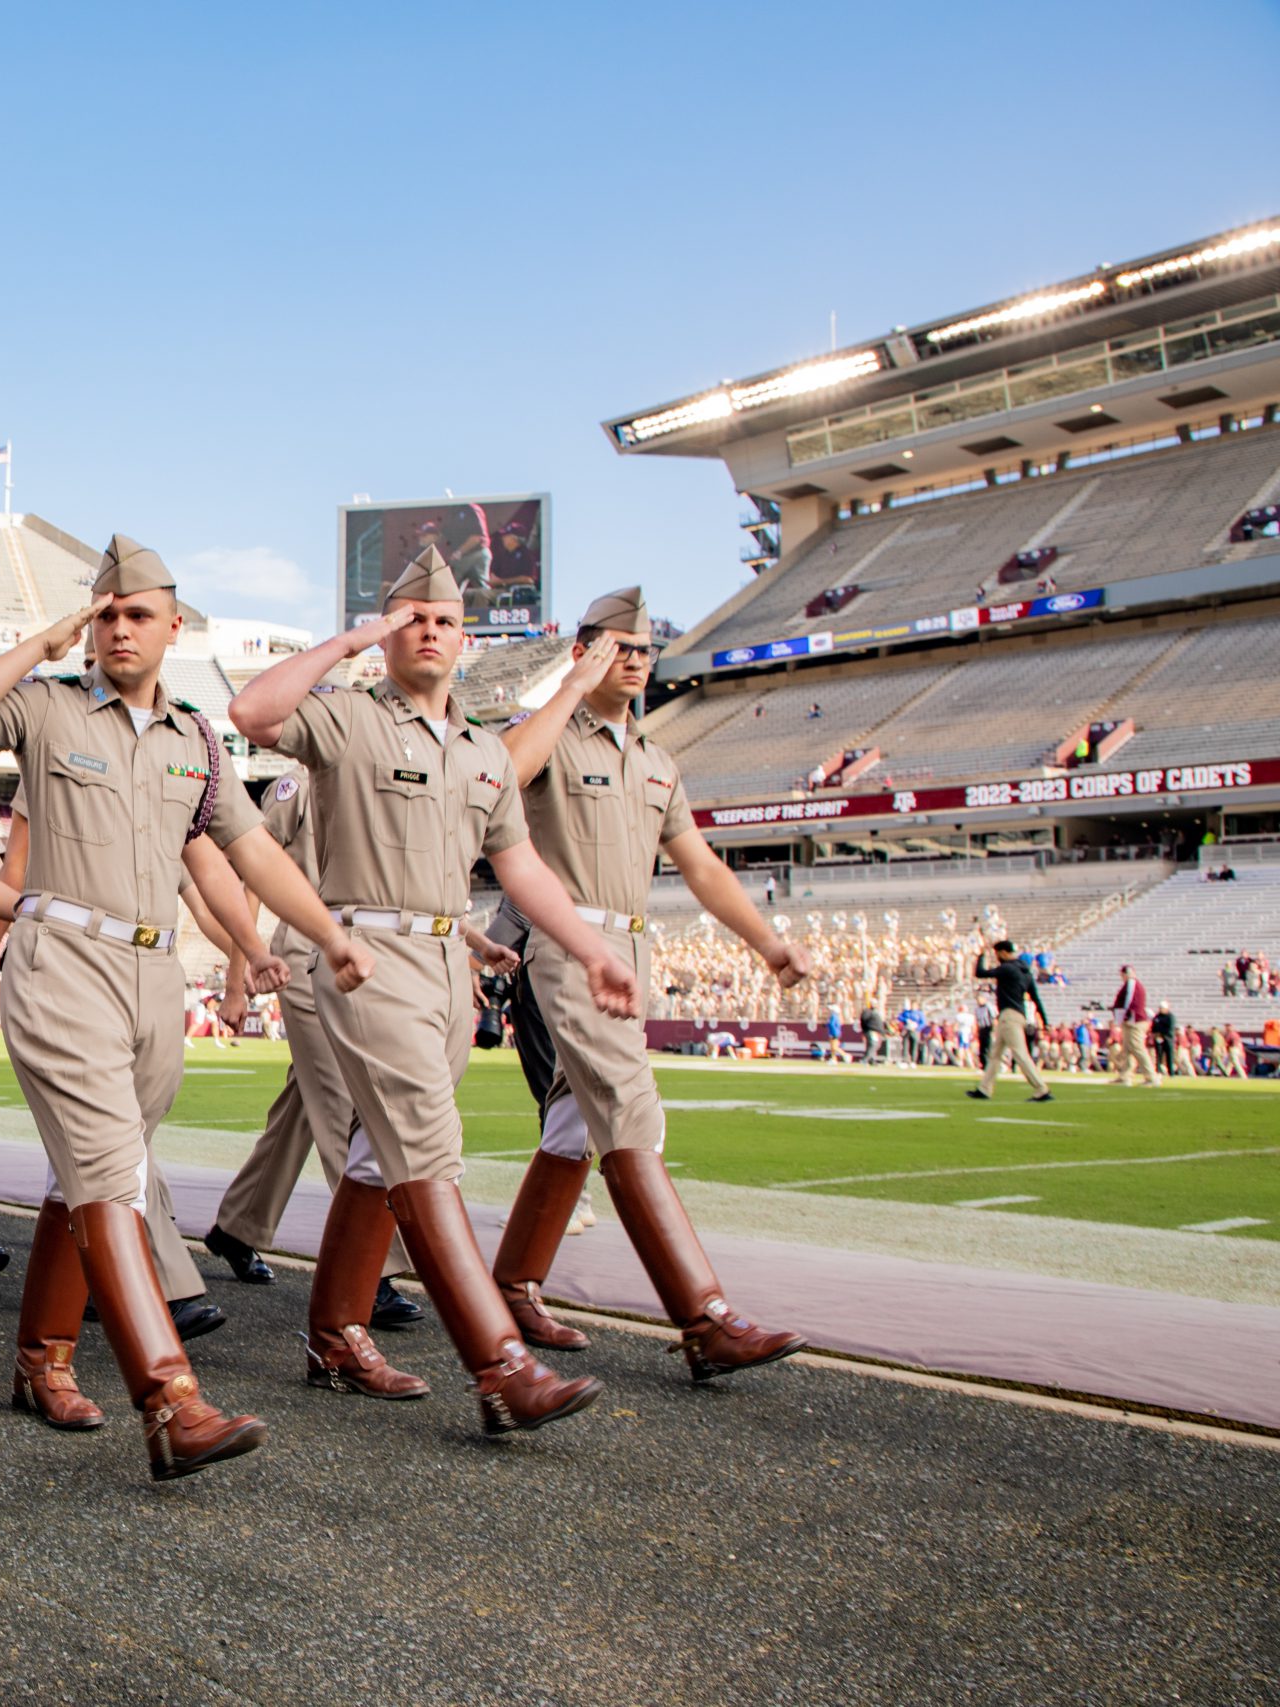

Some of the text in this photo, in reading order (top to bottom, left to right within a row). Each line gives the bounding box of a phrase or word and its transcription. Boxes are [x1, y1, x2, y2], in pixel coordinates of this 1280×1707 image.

[966, 763, 1251, 806] 2022-2023 CORPS OF CADETS
[711, 800, 849, 825] "KEEPERS OF THE SPIRIT"
